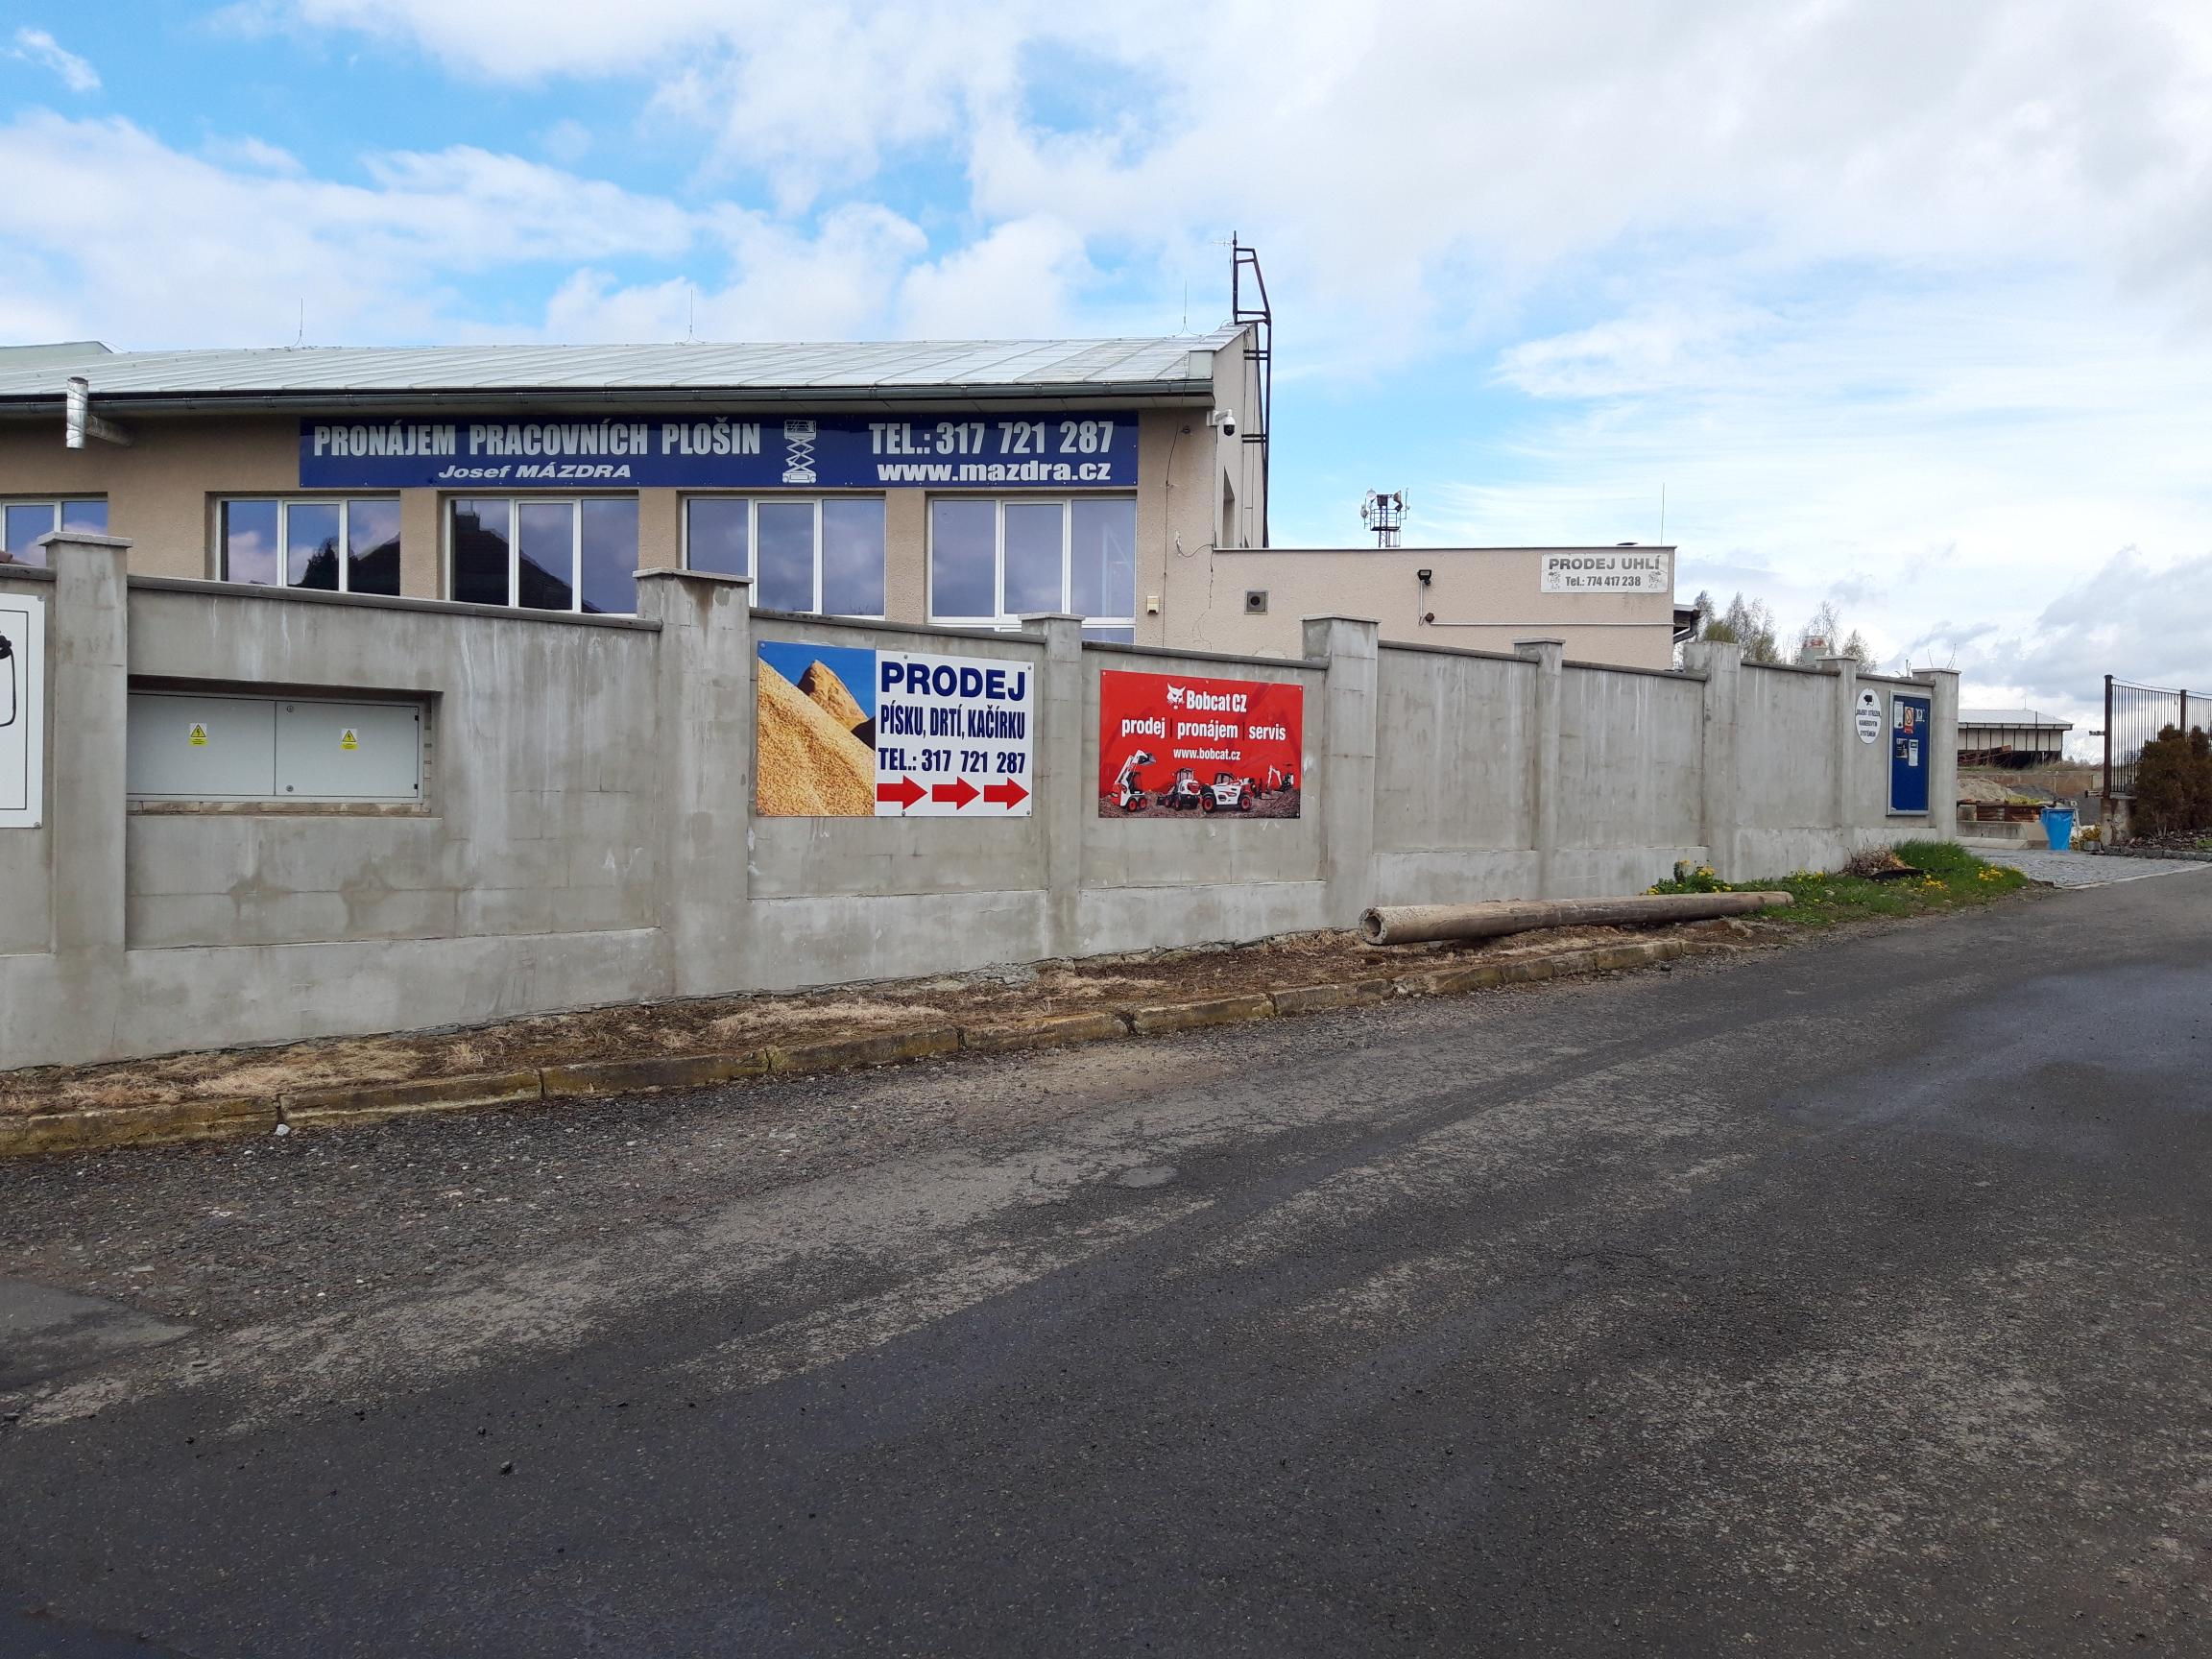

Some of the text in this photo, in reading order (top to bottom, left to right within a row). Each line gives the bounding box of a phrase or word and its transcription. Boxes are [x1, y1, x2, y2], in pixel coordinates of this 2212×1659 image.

[314, 417, 760, 457] PRONÁJEM PRACOVNÍCH PLOŠIN
[869, 421, 1114, 454] TEL.: 317 721 287
[438, 461, 632, 479] Josef MÁZDRA
[878, 461, 1111, 480] www.mazdra.cz
[1549, 555, 1661, 570] PRODEJ UHLÍ
[1565, 576, 1641, 587] Tel.: 774 417 238
[881, 661, 1025, 701] PRODEJ
[1187, 690, 1247, 712] Bobcat CZ
[880, 700, 1025, 740] PÍSKU, DRTÍ, KAČÍRKU
[1121, 717, 1286, 741] prodej pronájem servis
[878, 747, 1025, 774] TEL.: 317 721 287
[1173, 747, 1240, 760] www.bobcat.cz
